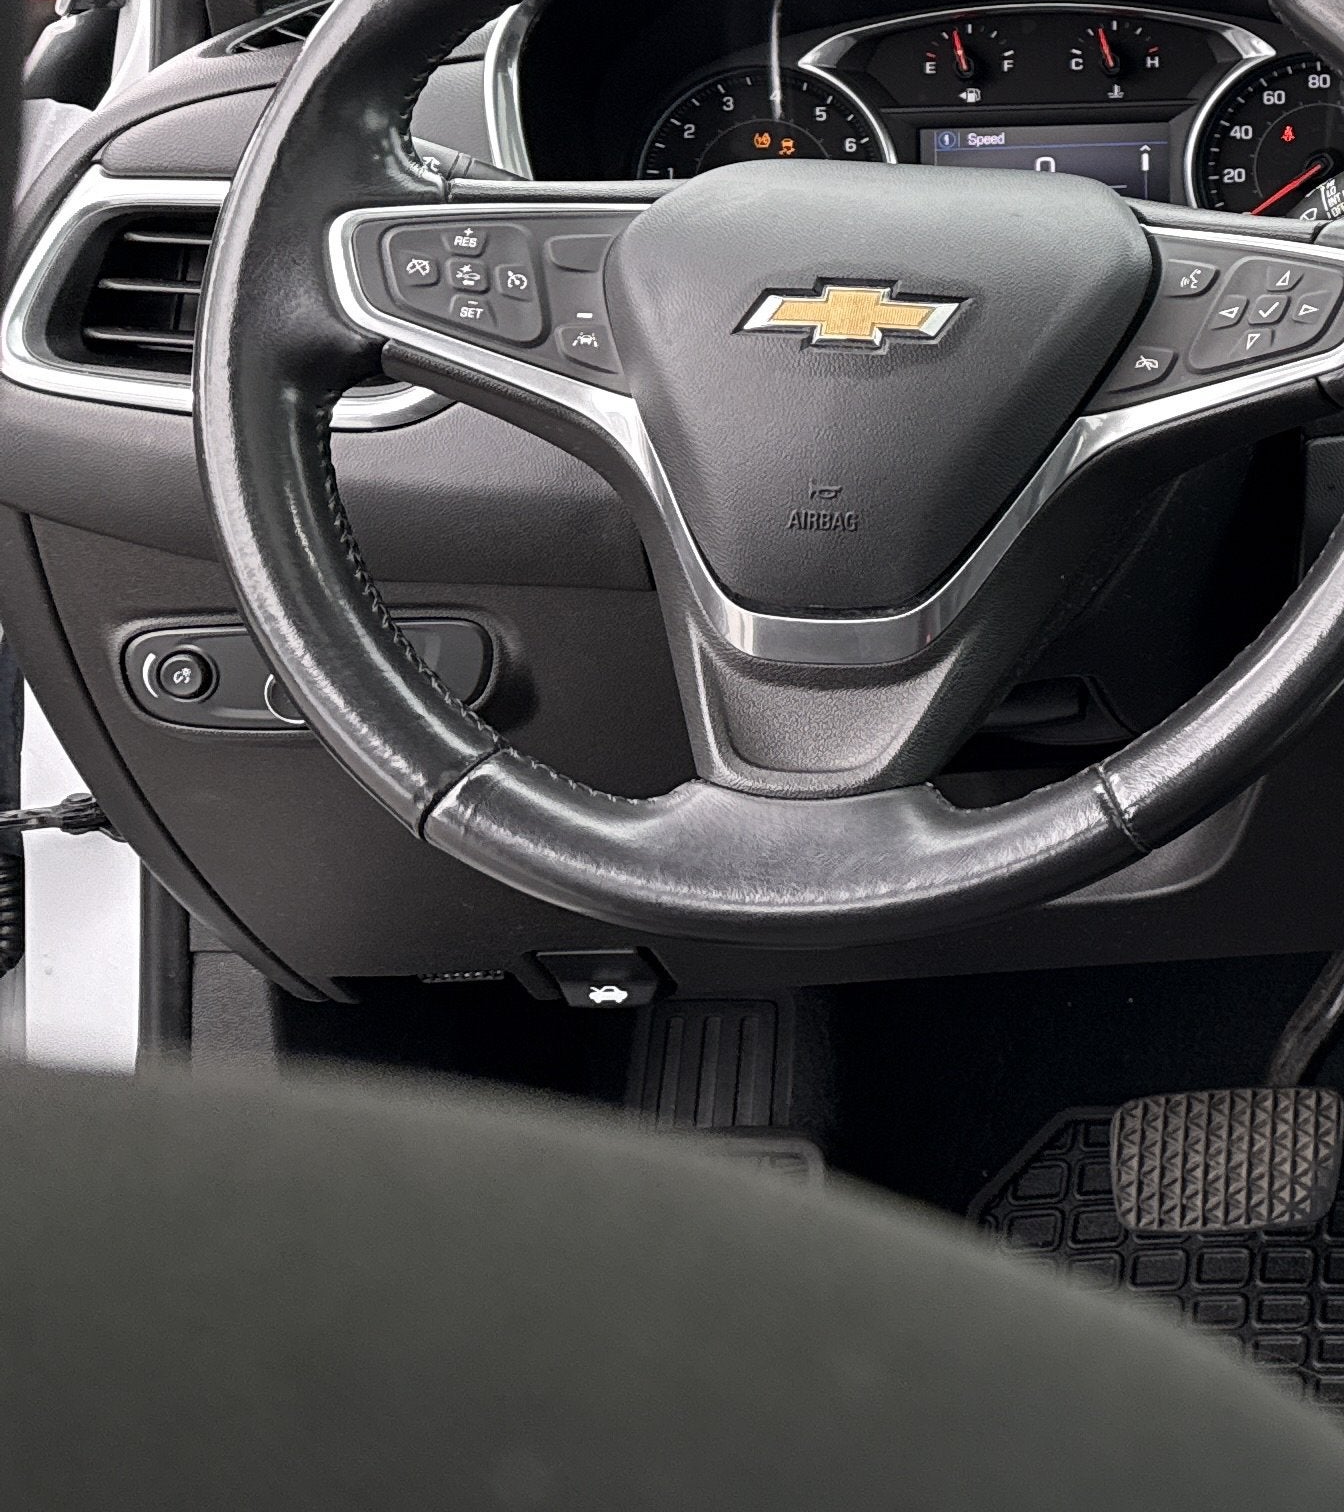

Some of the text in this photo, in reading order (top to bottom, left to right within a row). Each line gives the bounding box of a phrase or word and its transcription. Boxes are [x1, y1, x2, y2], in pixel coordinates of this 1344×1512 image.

[925, 62, 937, 74] E
[1003, 60, 1014, 73] F
[1071, 57, 1083, 70] C
[1146, 56, 1159, 68] H
[1308, 74, 1330, 89] 80
[722, 96, 734, 111] 3
[1263, 90, 1286, 105] 60
[815, 106, 827, 121] 5
[683, 124, 695, 138] 2
[1230, 125, 1253, 140] 40
[845, 138, 857, 153] 6
[967, 132, 1005, 148] Speed
[1223, 168, 1246, 183] 20
[454, 236, 477, 247] RES
[460, 307, 483, 319] SET
[785, 509, 859, 532] AIRBAG
